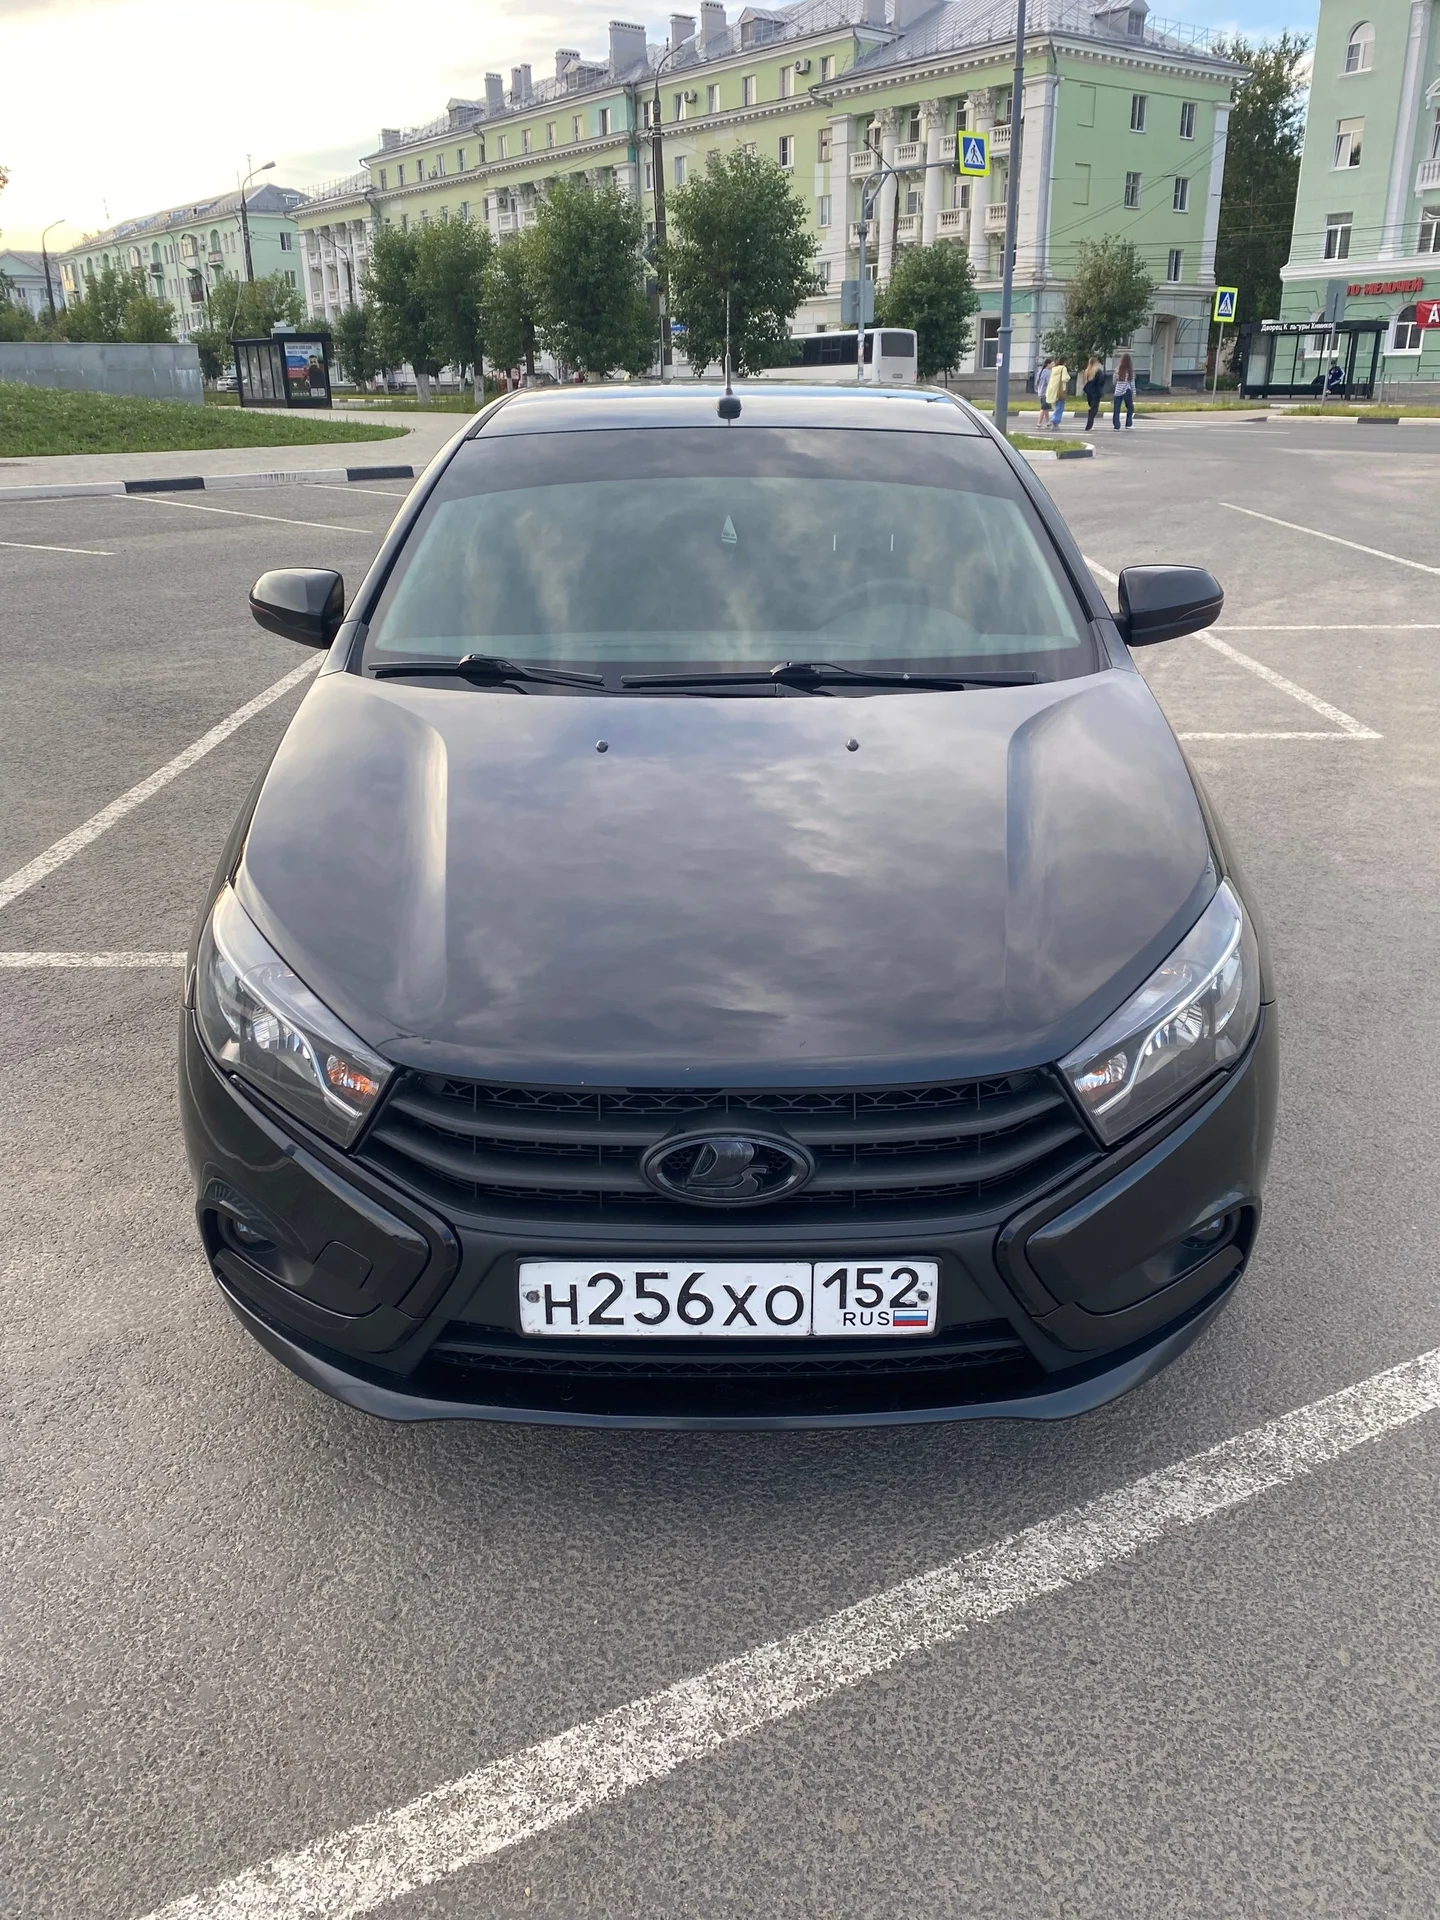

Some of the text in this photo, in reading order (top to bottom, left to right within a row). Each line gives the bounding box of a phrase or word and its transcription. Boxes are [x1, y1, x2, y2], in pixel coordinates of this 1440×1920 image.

[1364, 277, 1424, 295] МЕЛОЧЕЙ
[1260, 324, 1283, 332] Дворец
[1283, 323, 1310, 332] Кльтуры
[543, 1267, 919, 1326] Н256ХО 152
[843, 1311, 890, 1327] RUS
